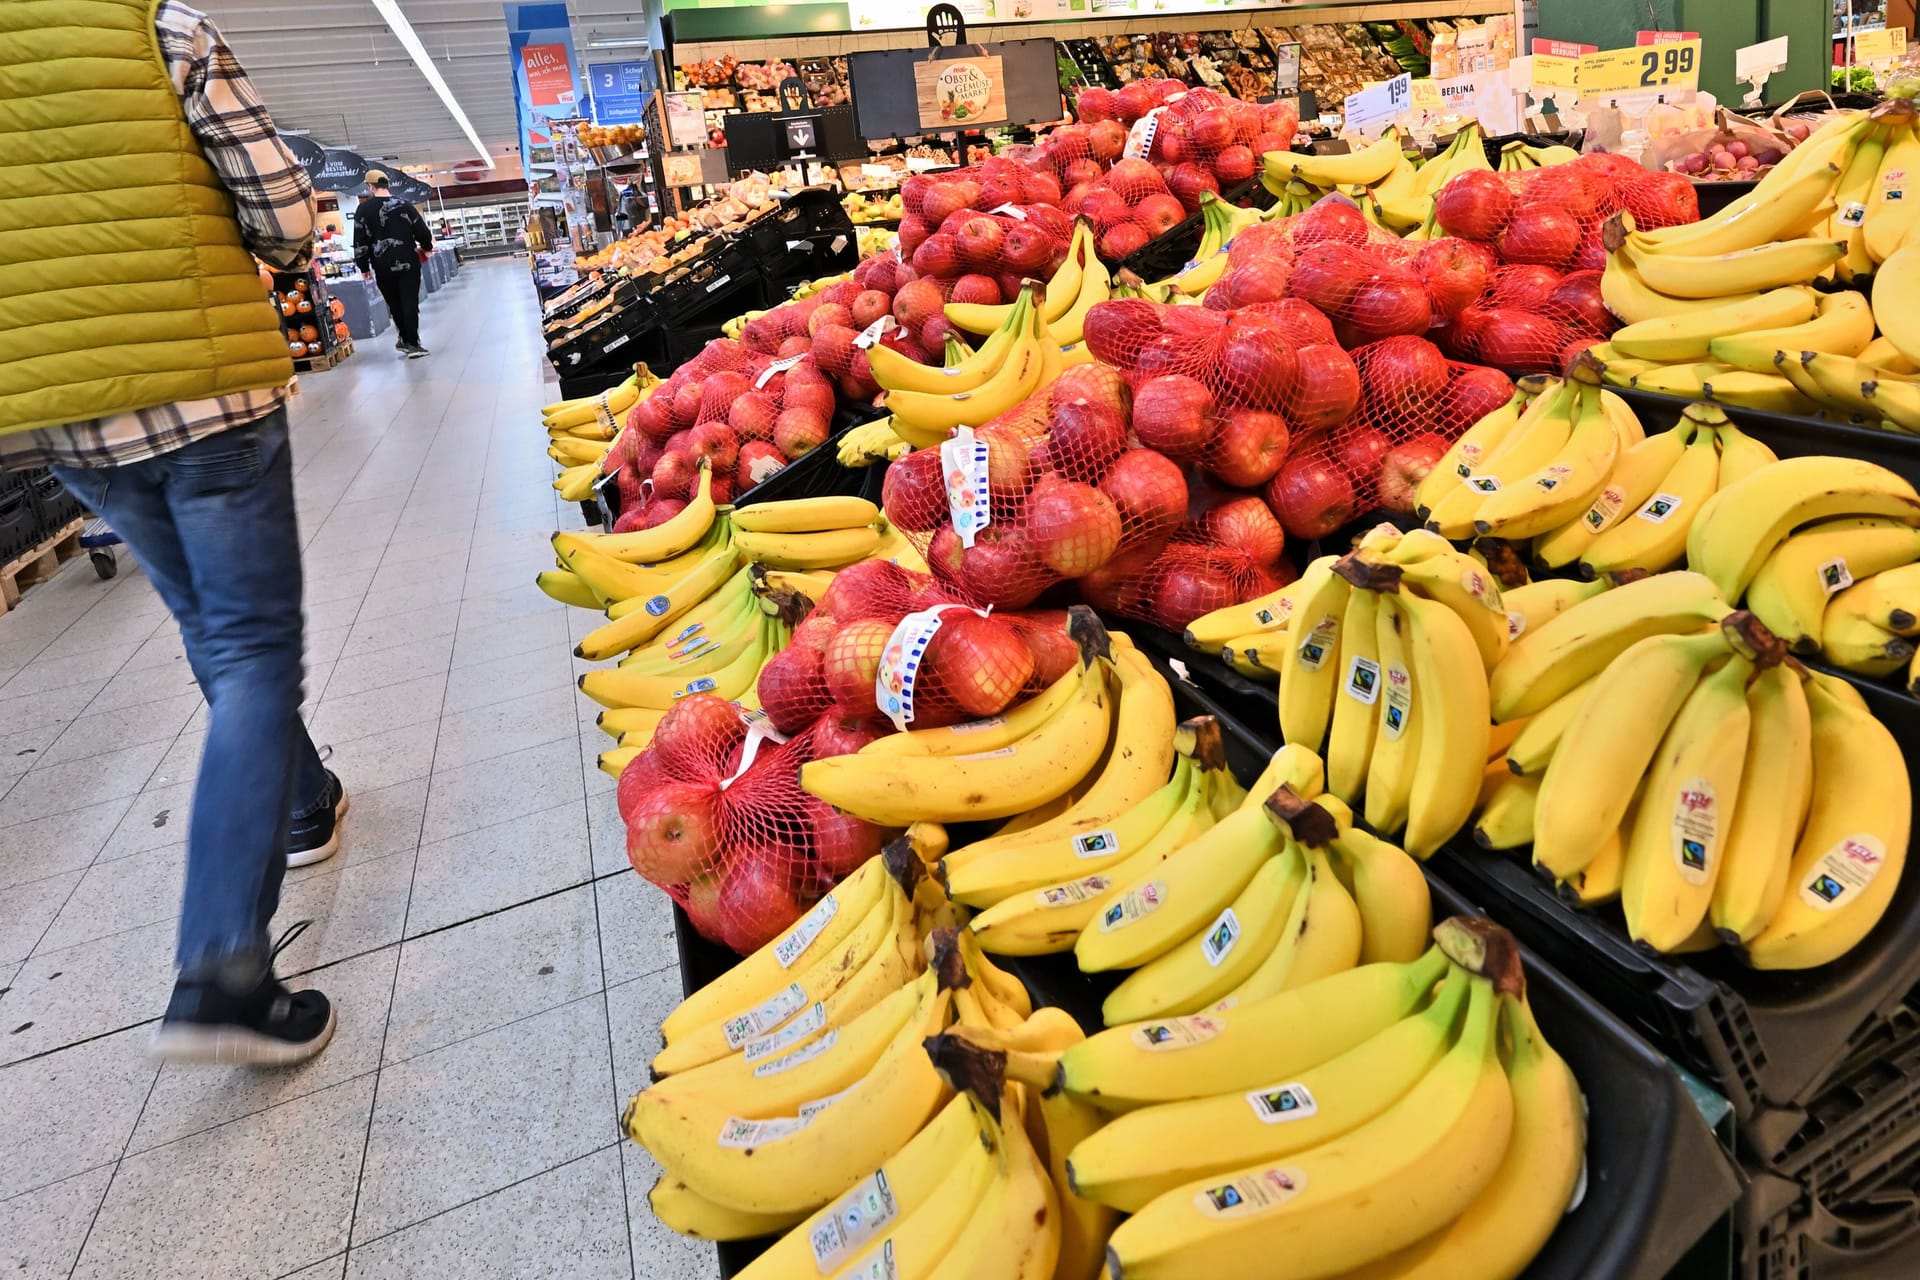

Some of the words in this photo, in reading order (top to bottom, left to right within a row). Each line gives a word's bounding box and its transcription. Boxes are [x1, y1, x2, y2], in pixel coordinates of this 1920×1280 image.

[527, 51, 559, 68] alles,
[1641, 47, 1694, 87] 2.99
[603, 73, 614, 88] 3
[945, 74, 969, 84] OBST
[969, 69, 978, 81] &
[960, 89, 987, 101] MARKT
[1387, 77, 1408, 105] 1.99
[1441, 84, 1475, 97] BERLINA
